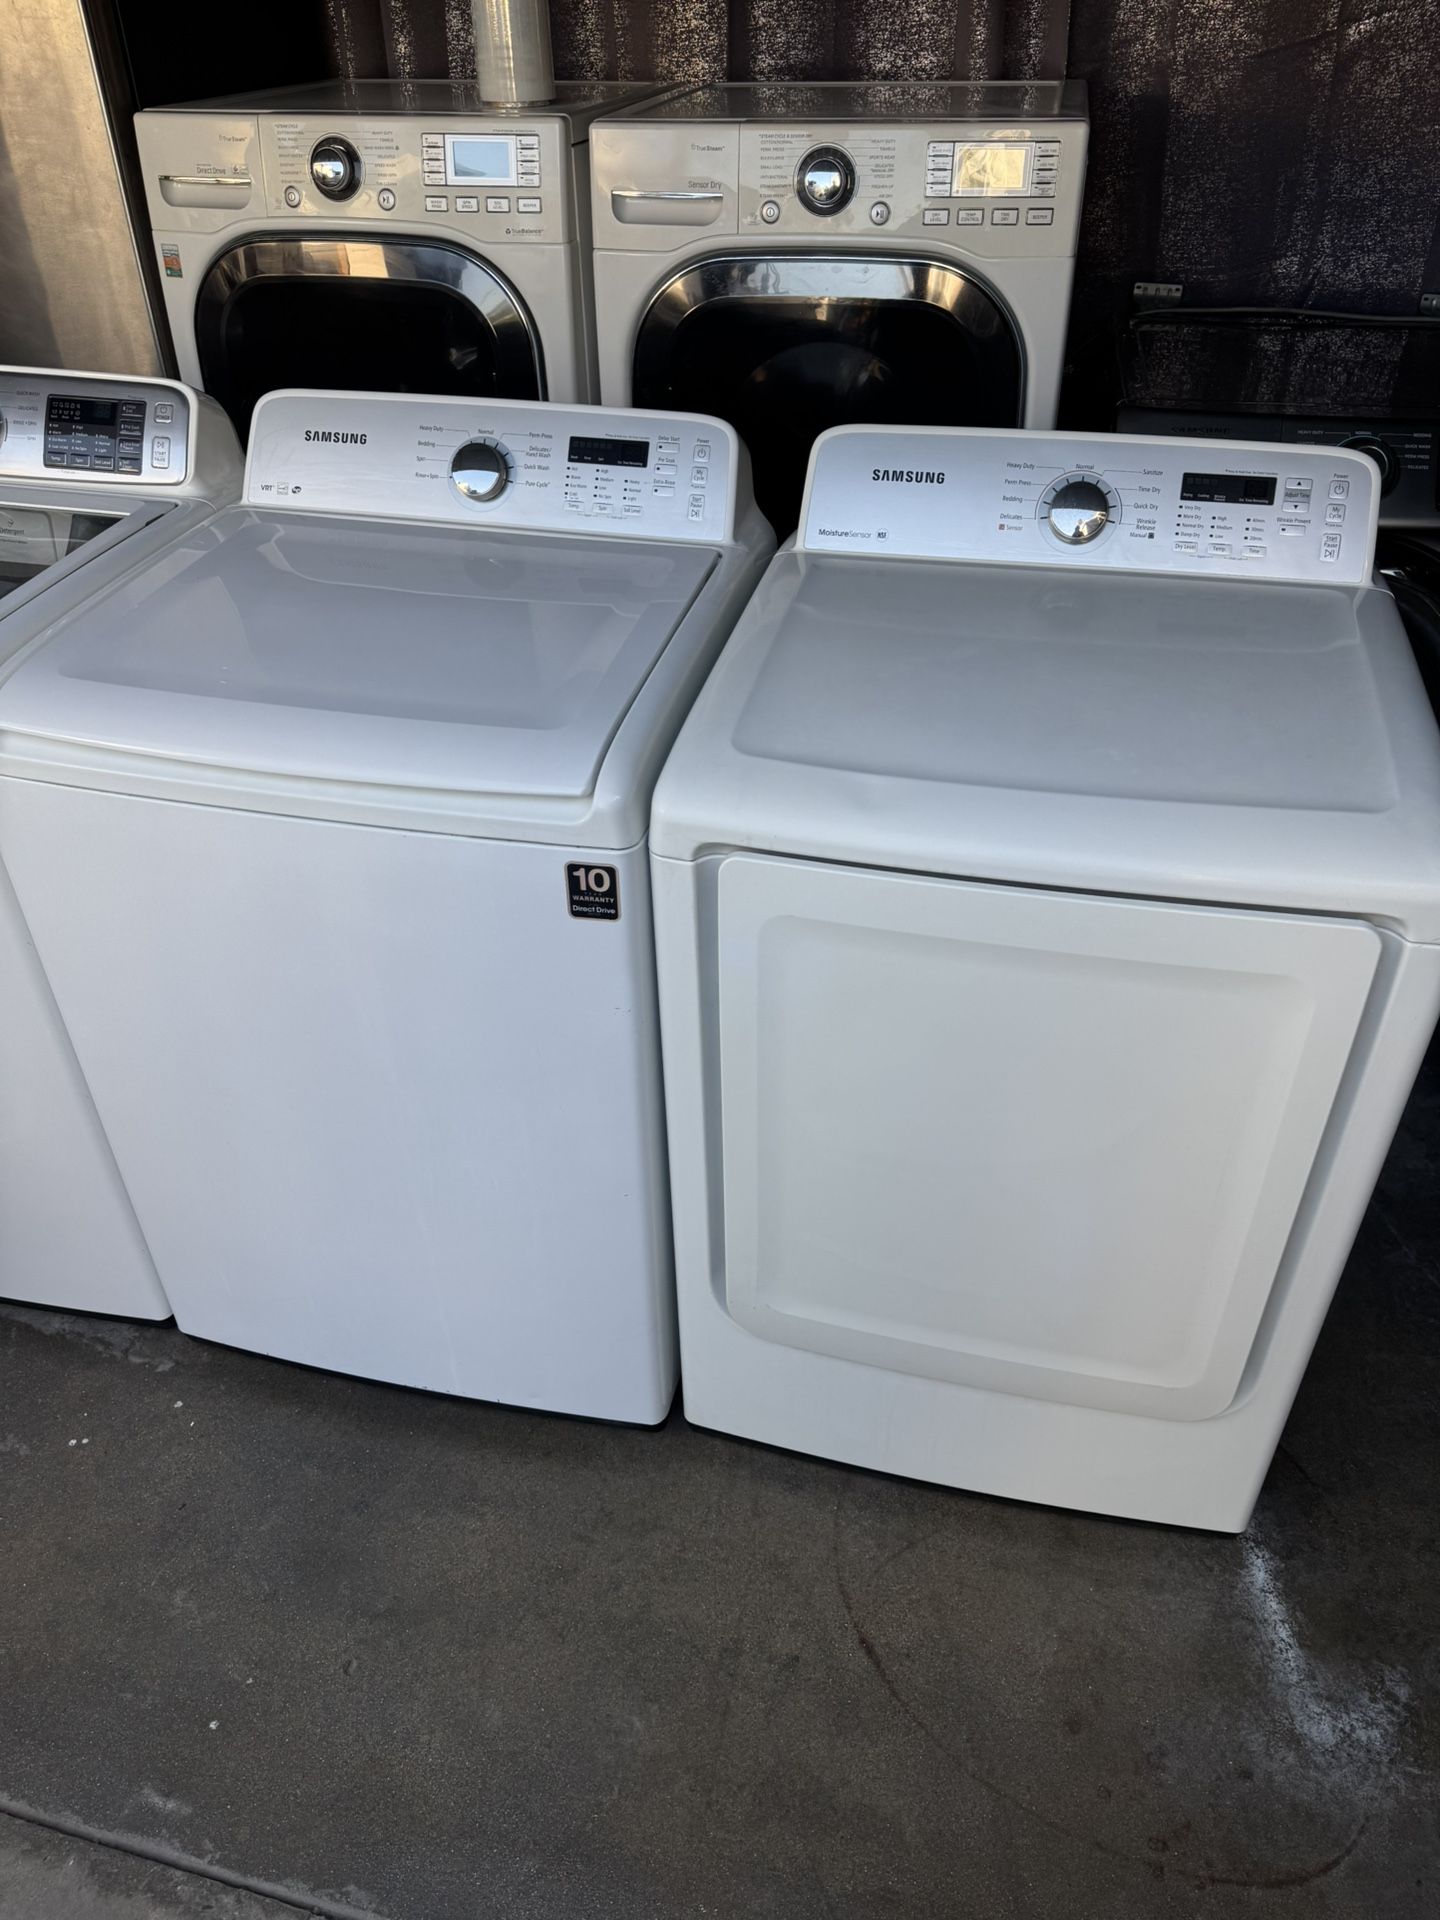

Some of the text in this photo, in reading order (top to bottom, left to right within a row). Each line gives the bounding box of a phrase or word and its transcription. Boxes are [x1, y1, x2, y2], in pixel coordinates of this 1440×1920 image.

[710, 182, 722, 190] Dry
[304, 430, 367, 445] SAMSUNG
[418, 440, 435, 448] Bedding
[872, 469, 945, 484] SAMSUNG
[1285, 491, 1299, 499] Adjust
[573, 867, 611, 893] 10
[572, 895, 615, 903] WARRANTY
[572, 905, 595, 913] Direct
